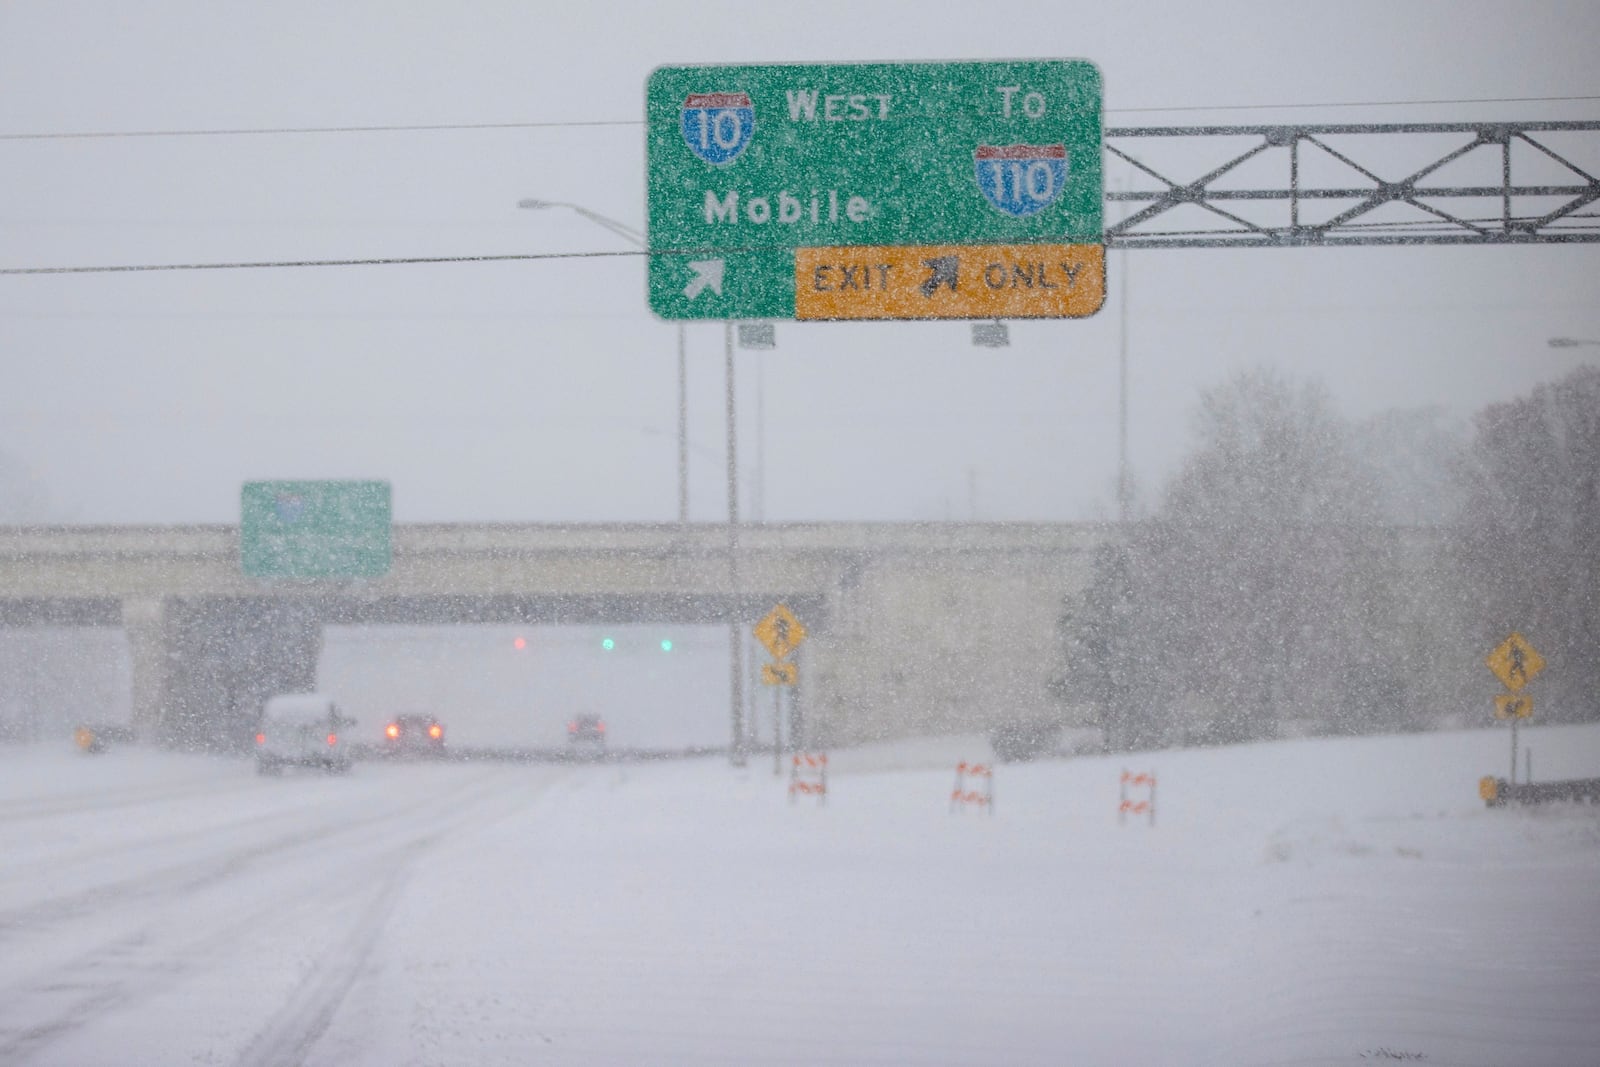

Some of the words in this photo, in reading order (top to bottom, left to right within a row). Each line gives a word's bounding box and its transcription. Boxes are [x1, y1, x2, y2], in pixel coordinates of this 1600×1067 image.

[786, 89, 892, 121] WEST
[697, 110, 741, 149] 10
[992, 162, 1054, 200] 110
[704, 188, 868, 225] Mobile
[814, 263, 893, 291] EXIT
[985, 261, 1082, 289] ONLY
